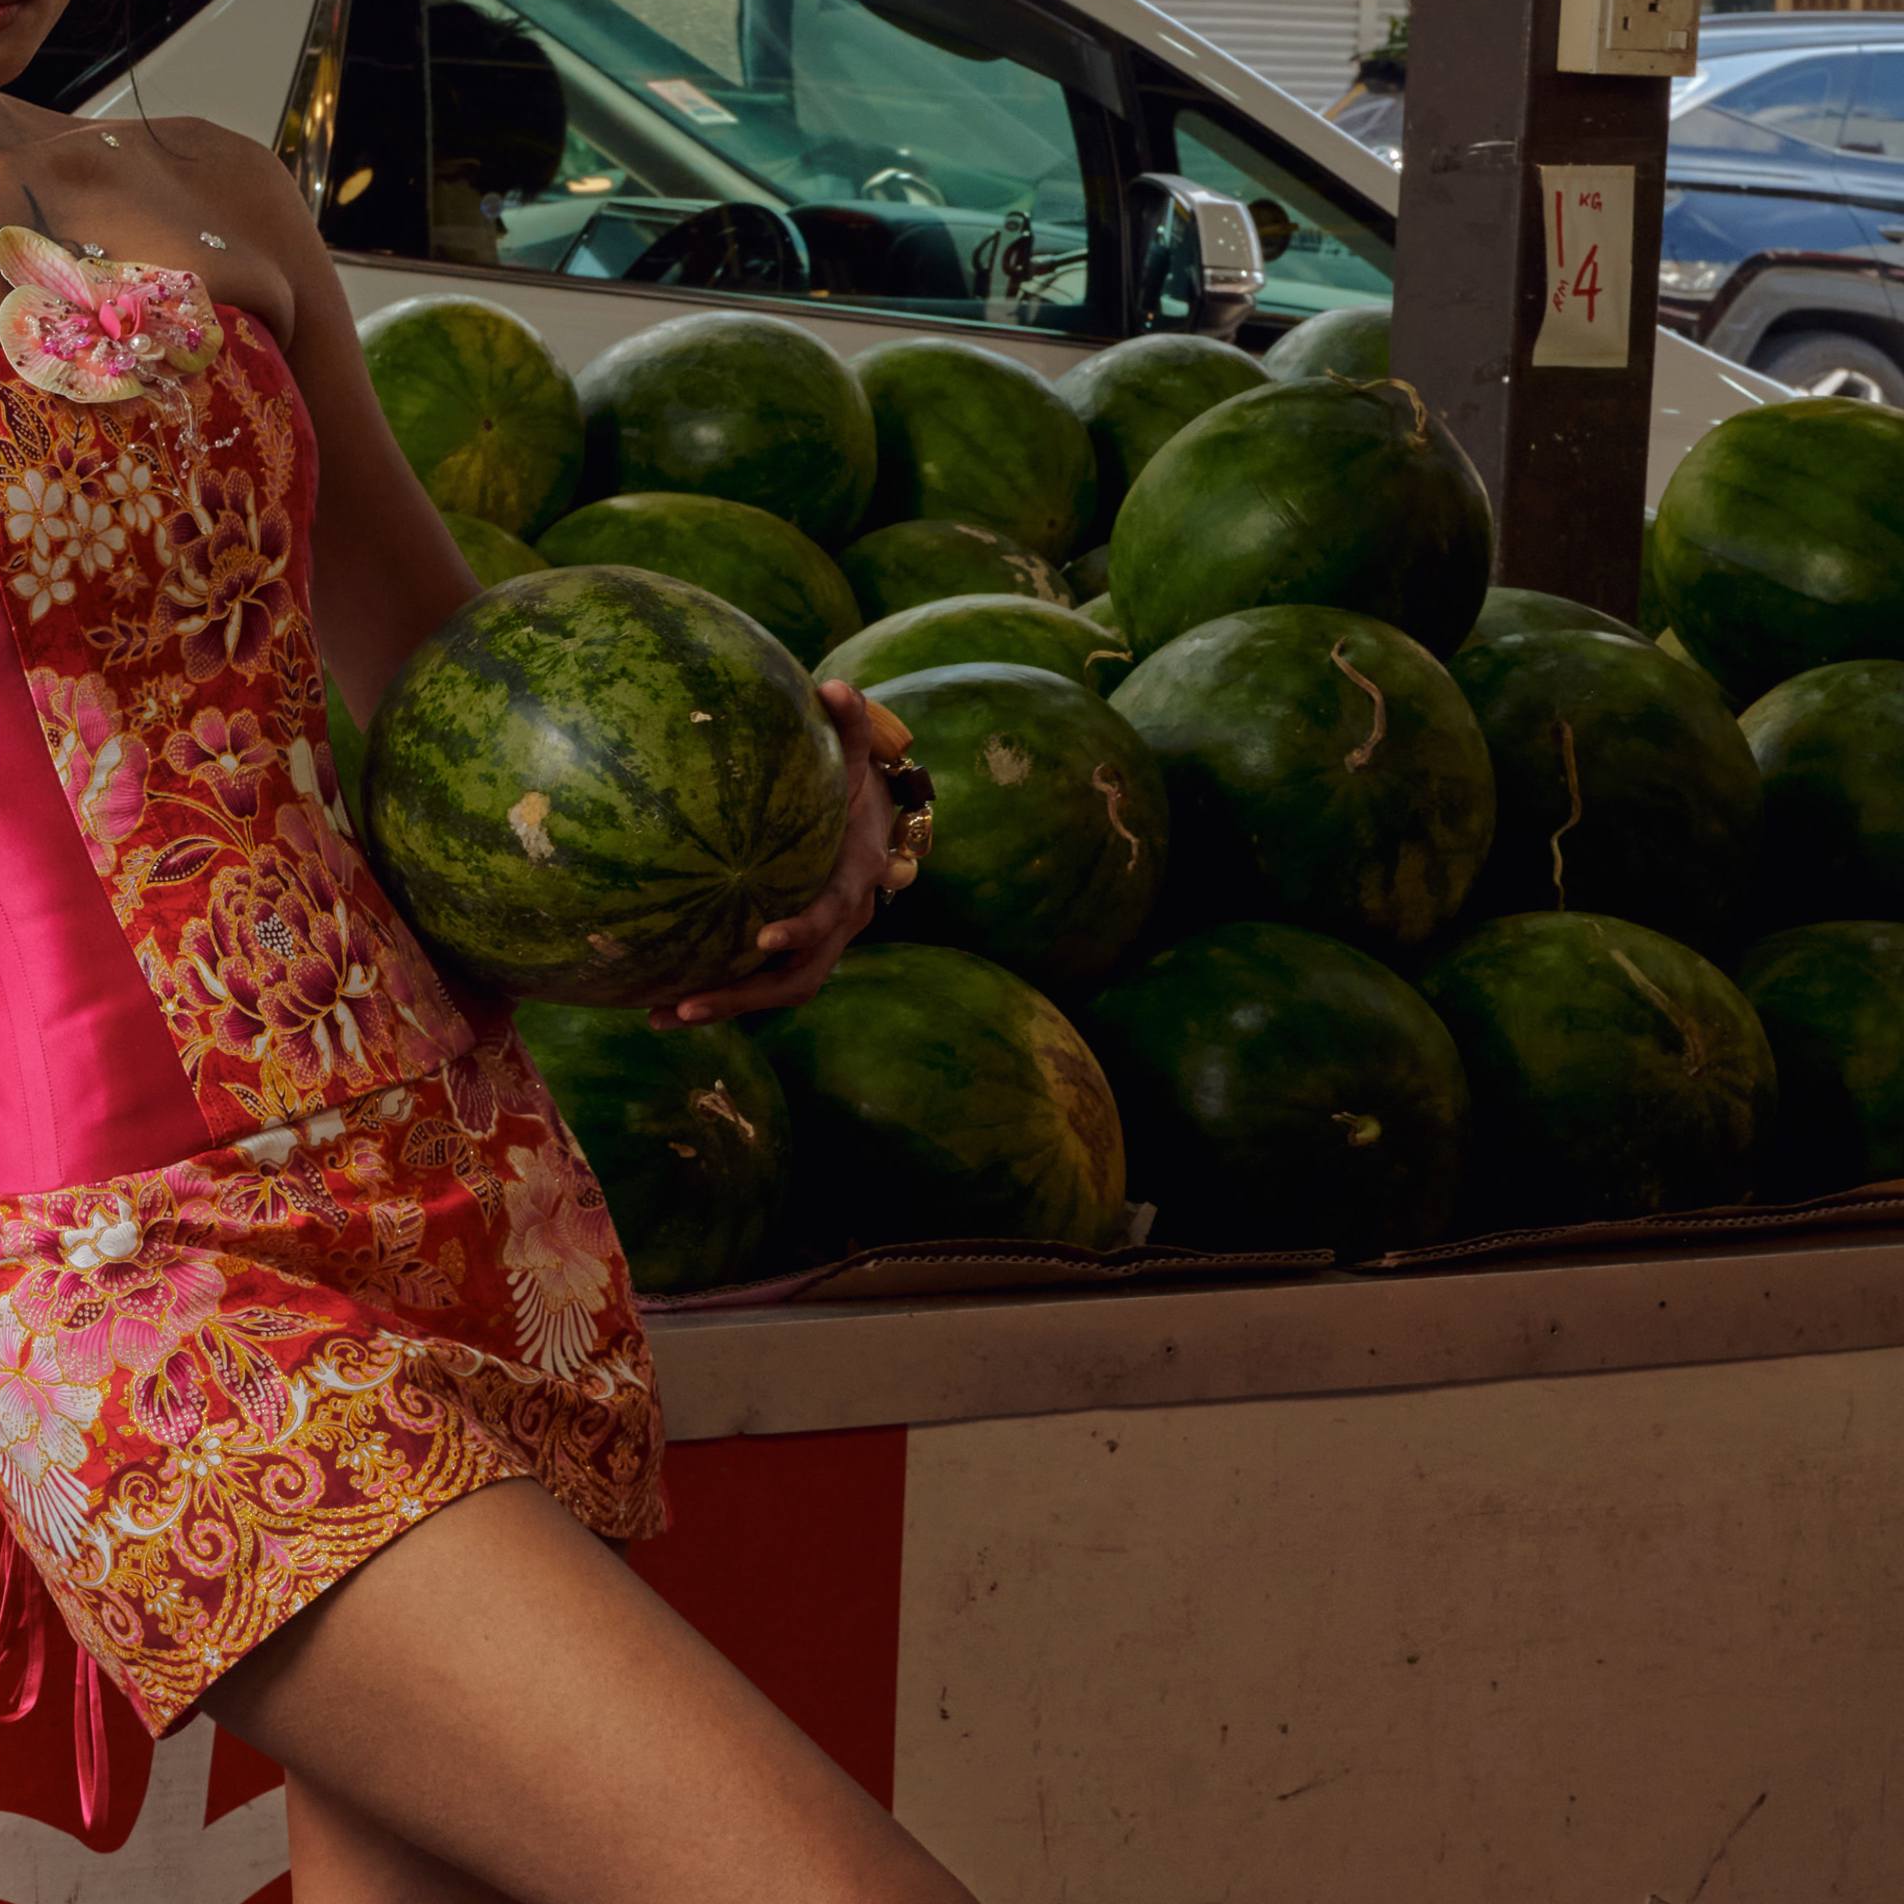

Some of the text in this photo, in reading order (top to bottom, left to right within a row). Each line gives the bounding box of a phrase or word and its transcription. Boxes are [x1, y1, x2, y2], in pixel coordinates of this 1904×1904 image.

[1578, 191, 1603, 212] KG
[1552, 243, 1603, 323] RM 4
